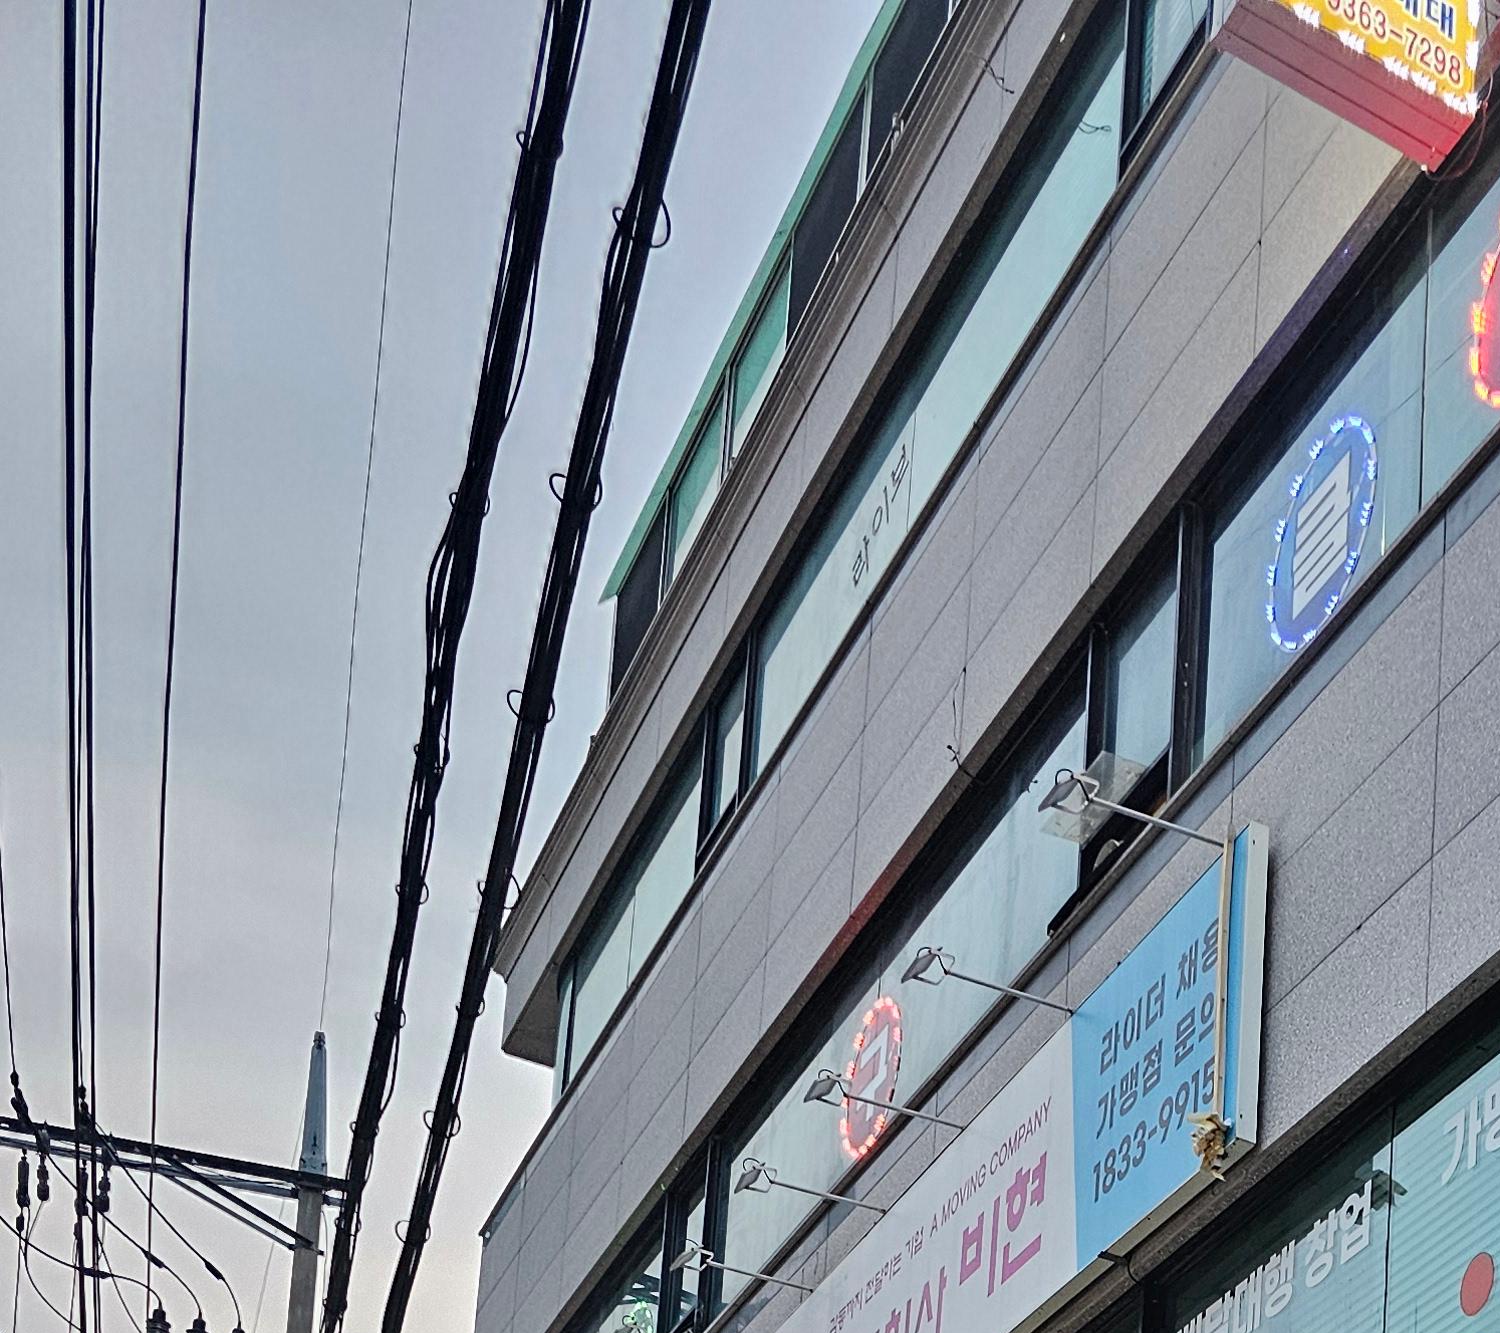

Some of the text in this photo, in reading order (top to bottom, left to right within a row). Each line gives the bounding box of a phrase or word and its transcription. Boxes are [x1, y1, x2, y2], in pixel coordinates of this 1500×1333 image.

[850, 443, 909, 586] 라이브
[1099, 917, 1218, 1077] 라이더 채용
[1092, 1056, 1216, 1203] 1833-9915
[1095, 1039, 1163, 1141] 가맹점
[930, 1216, 939, 1241] A
[940, 1163, 986, 1229] MOVING
[989, 1096, 1052, 1175] COMPANY
[959, 1150, 1047, 1298] 비현
[1305, 1179, 1373, 1289] 창업
